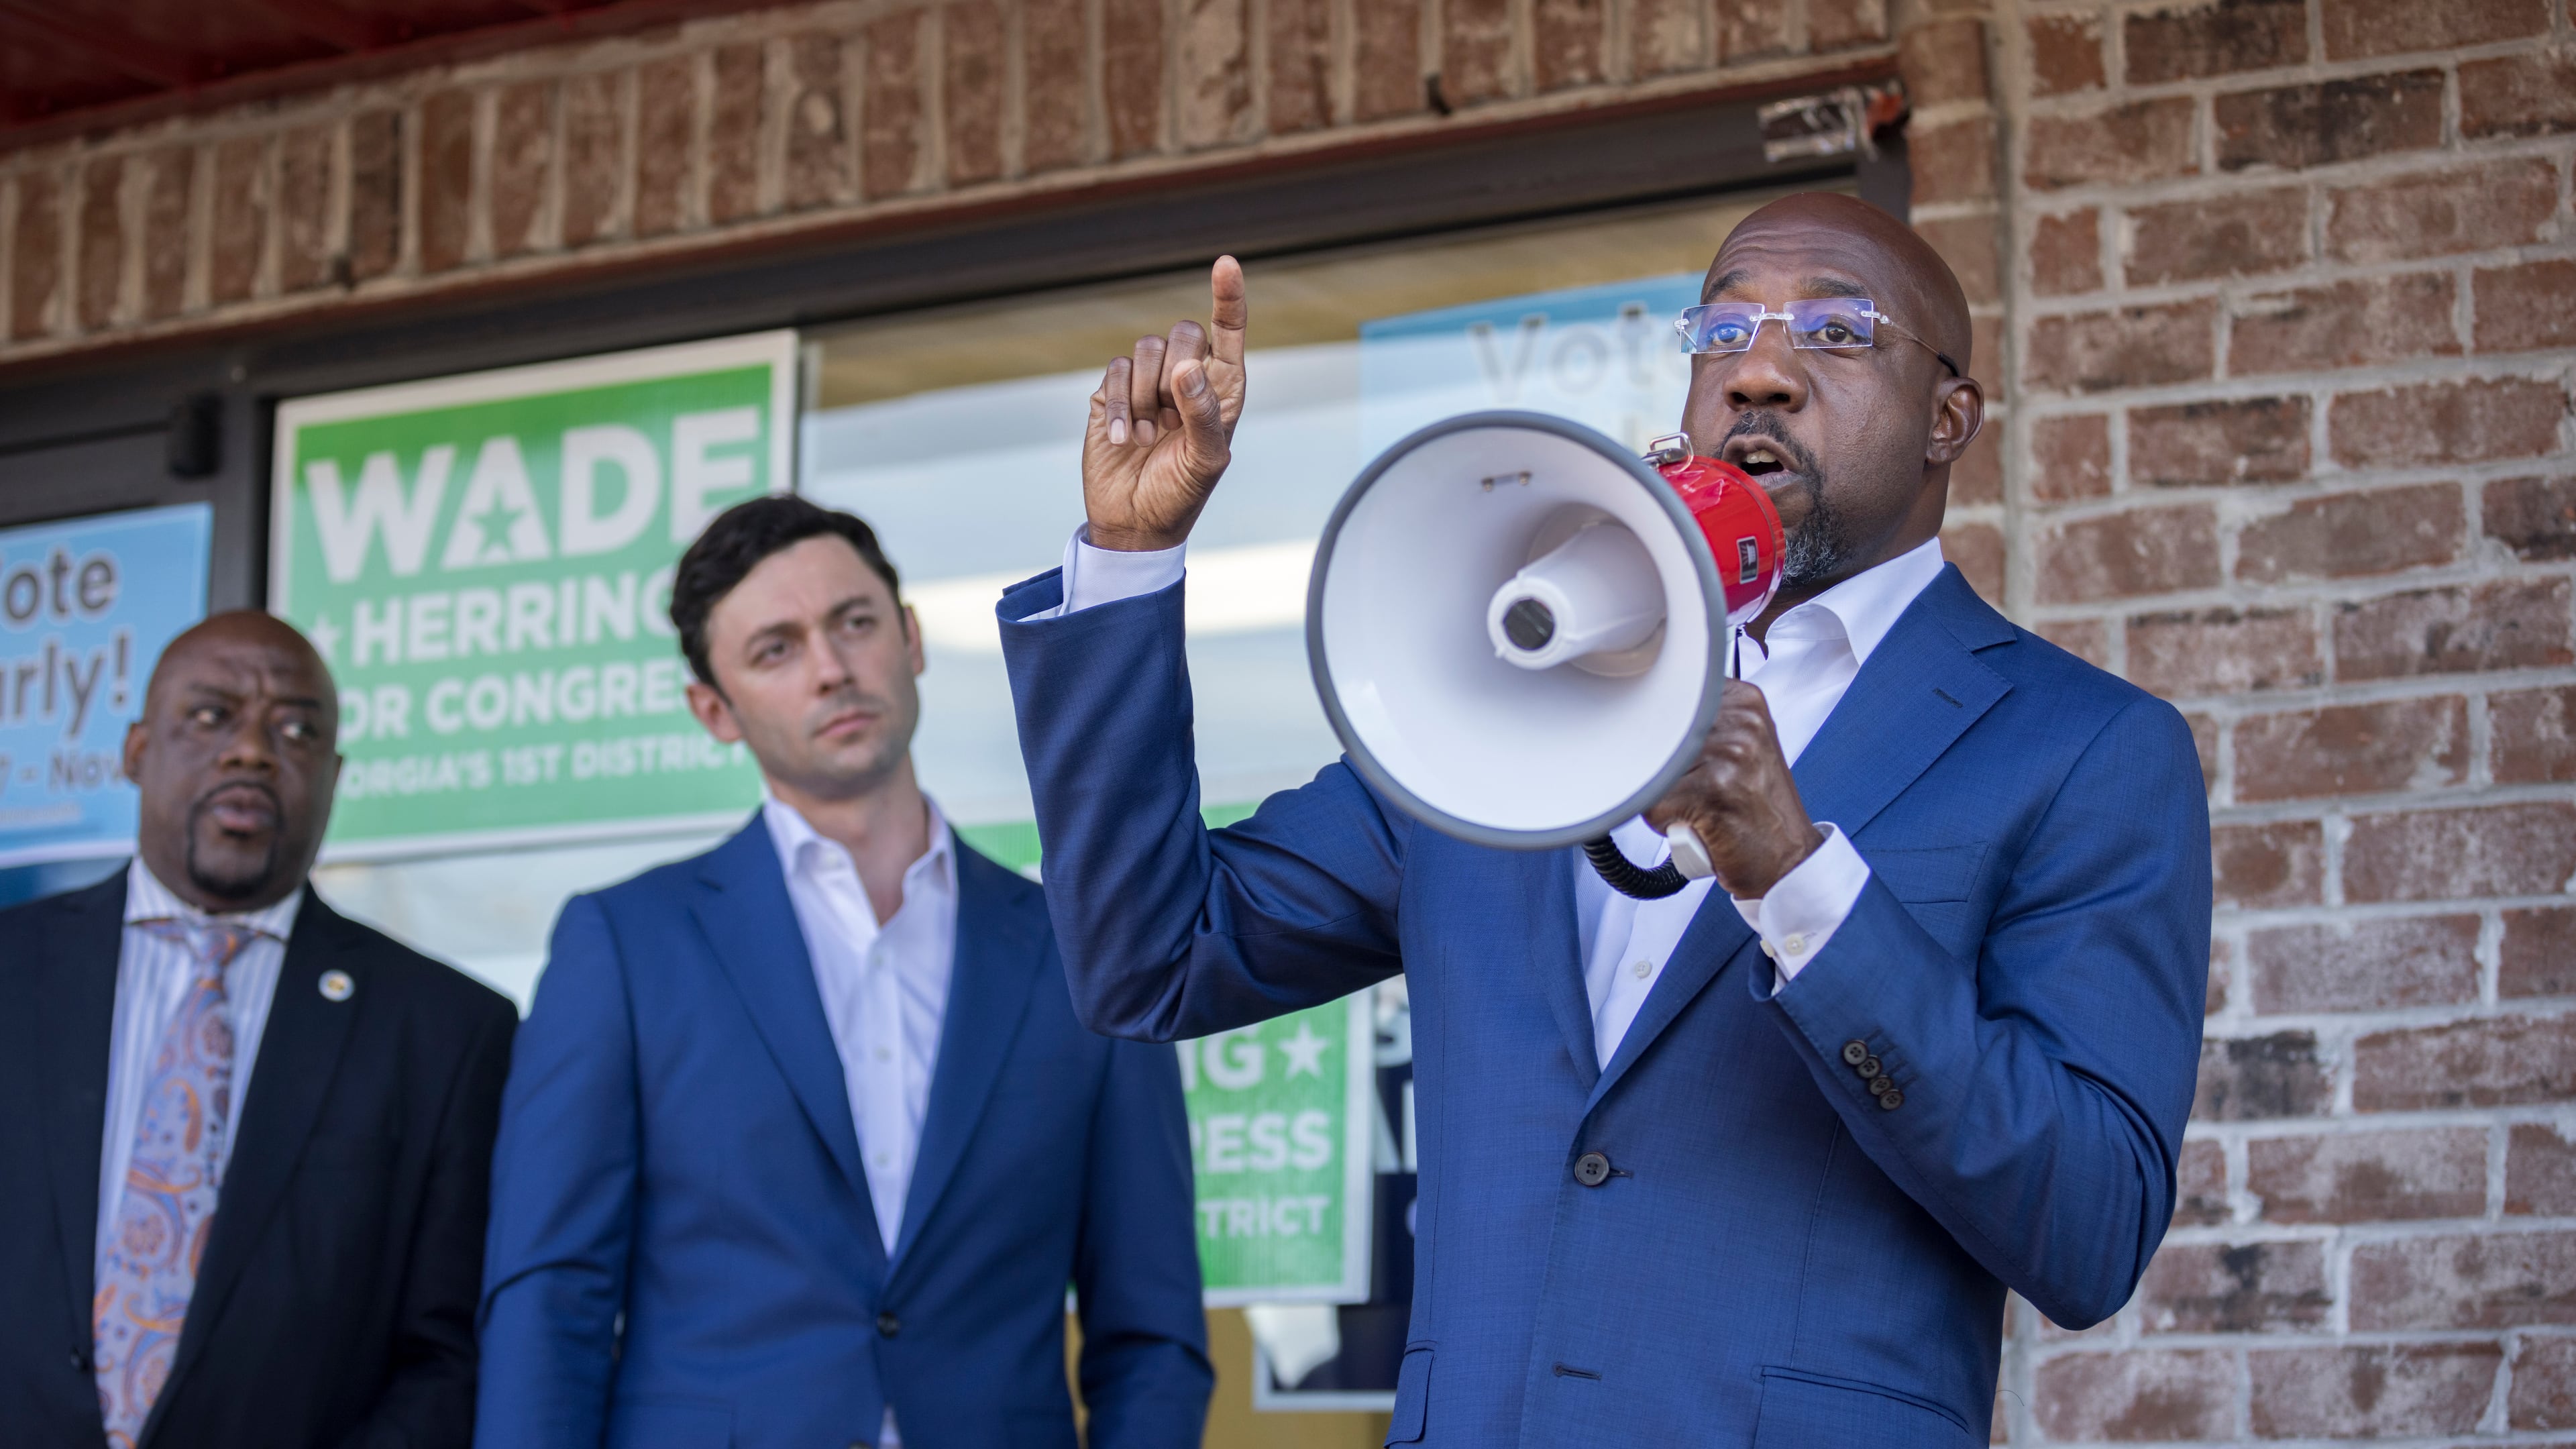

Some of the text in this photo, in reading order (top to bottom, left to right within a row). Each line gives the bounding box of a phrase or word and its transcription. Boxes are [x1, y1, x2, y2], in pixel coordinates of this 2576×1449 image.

[305, 407, 760, 582] WADE
[0, 549, 119, 624] ote
[0, 632, 129, 741] rly!
[337, 657, 695, 743] OR CONGRE
[341, 750, 492, 800] ORGIA'S
[503, 743, 565, 786] 1ST
[1197, 1194, 1330, 1238] TRICT
